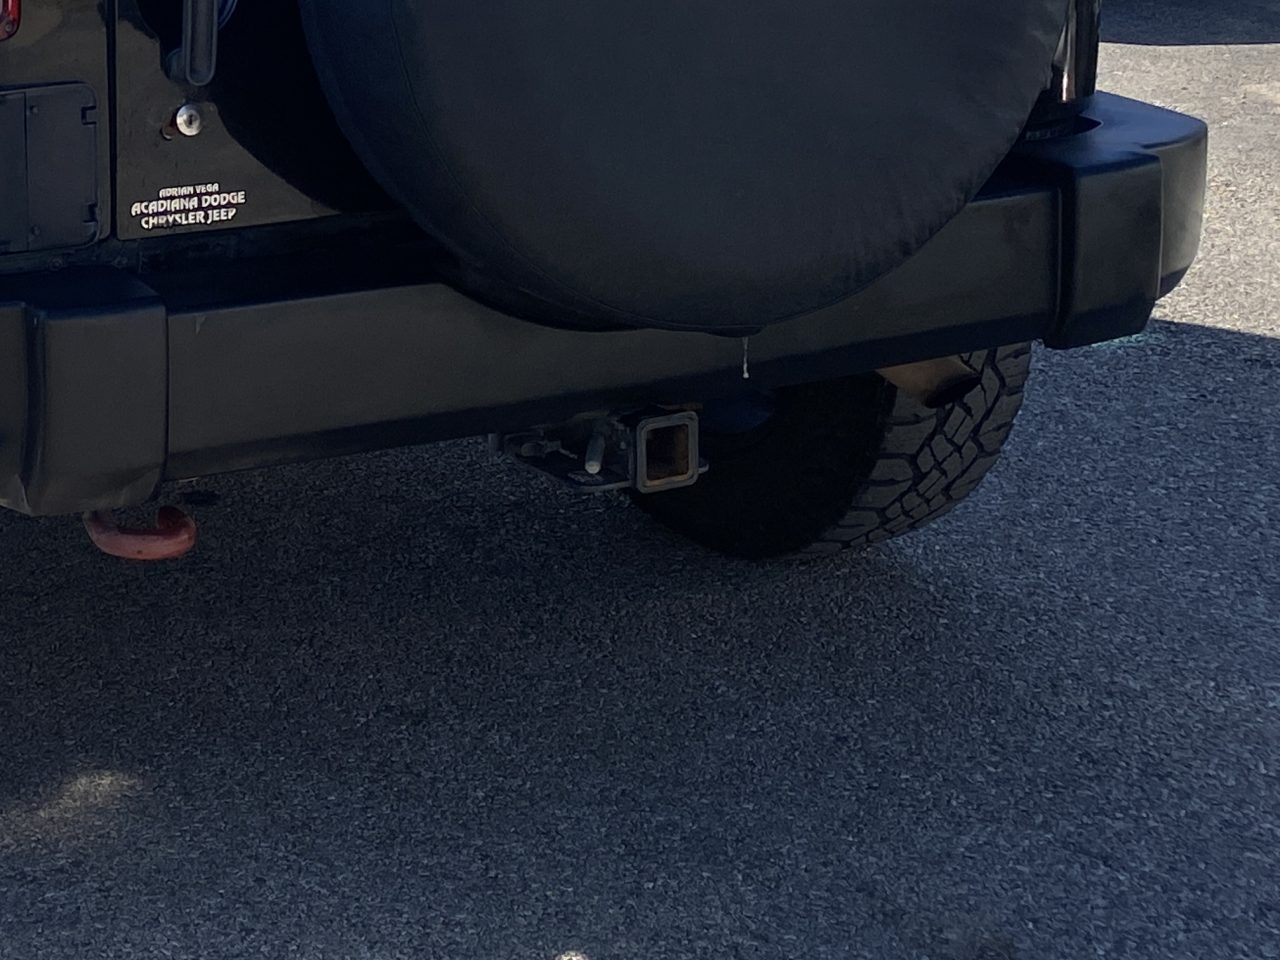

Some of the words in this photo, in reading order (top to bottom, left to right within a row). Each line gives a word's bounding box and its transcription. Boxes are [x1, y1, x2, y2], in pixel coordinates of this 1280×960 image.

[158, 185, 194, 199] ADRIAN
[194, 182, 219, 194] VEGA
[130, 196, 199, 217] ACADIANA
[201, 190, 246, 208] DODGE
[140, 210, 205, 229] CHRYSLER
[206, 207, 237, 225] JEEP
